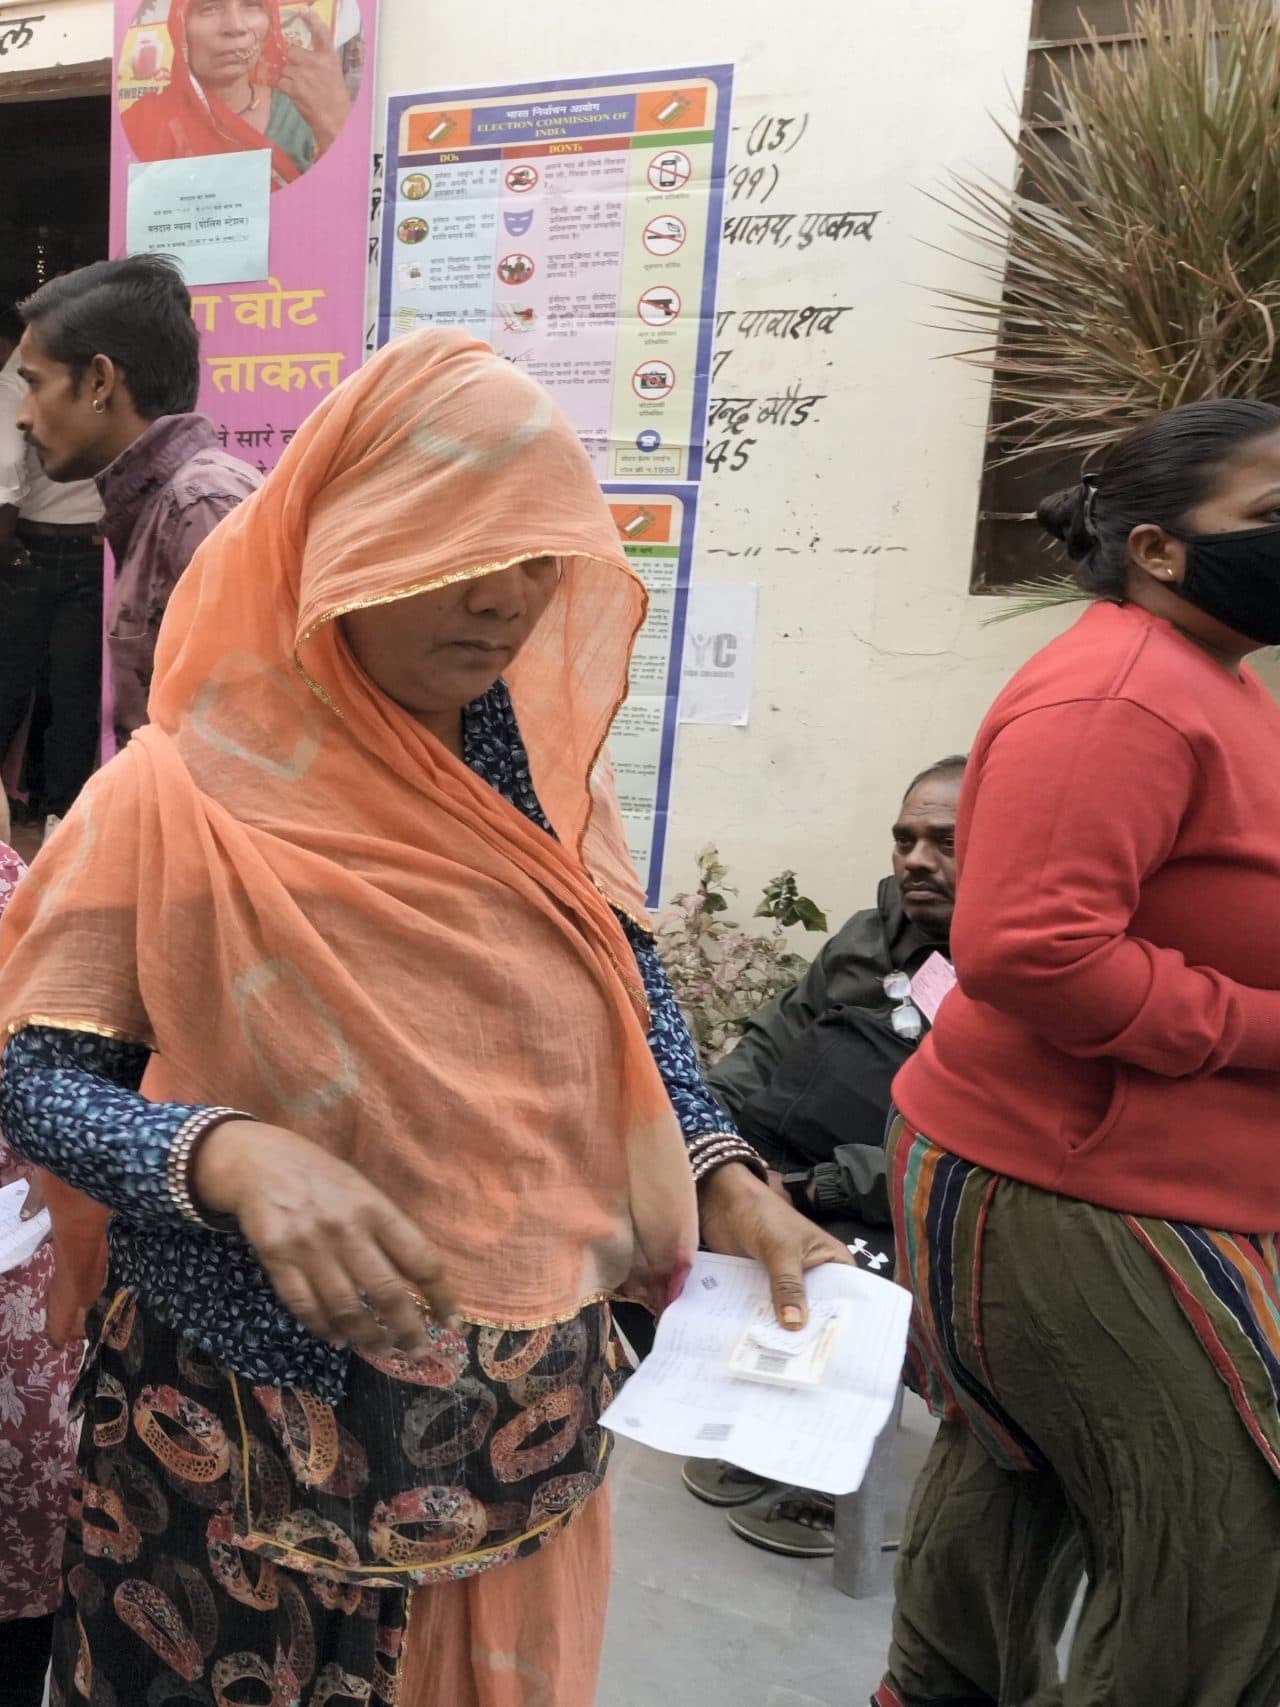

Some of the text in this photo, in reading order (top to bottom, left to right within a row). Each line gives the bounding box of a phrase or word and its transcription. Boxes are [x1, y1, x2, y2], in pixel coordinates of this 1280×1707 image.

[477, 111, 629, 132] ELECTION COMMISSION OF
[506, 109, 530, 119] भारत
[570, 101, 601, 112] आयोग
[535, 128, 567, 137] INDIA
[228, 276, 326, 329] वोट
[207, 352, 346, 393] ताकत
[234, 424, 275, 448] सारे
[705, 438, 758, 474] 45
[686, 630, 738, 669] YC
